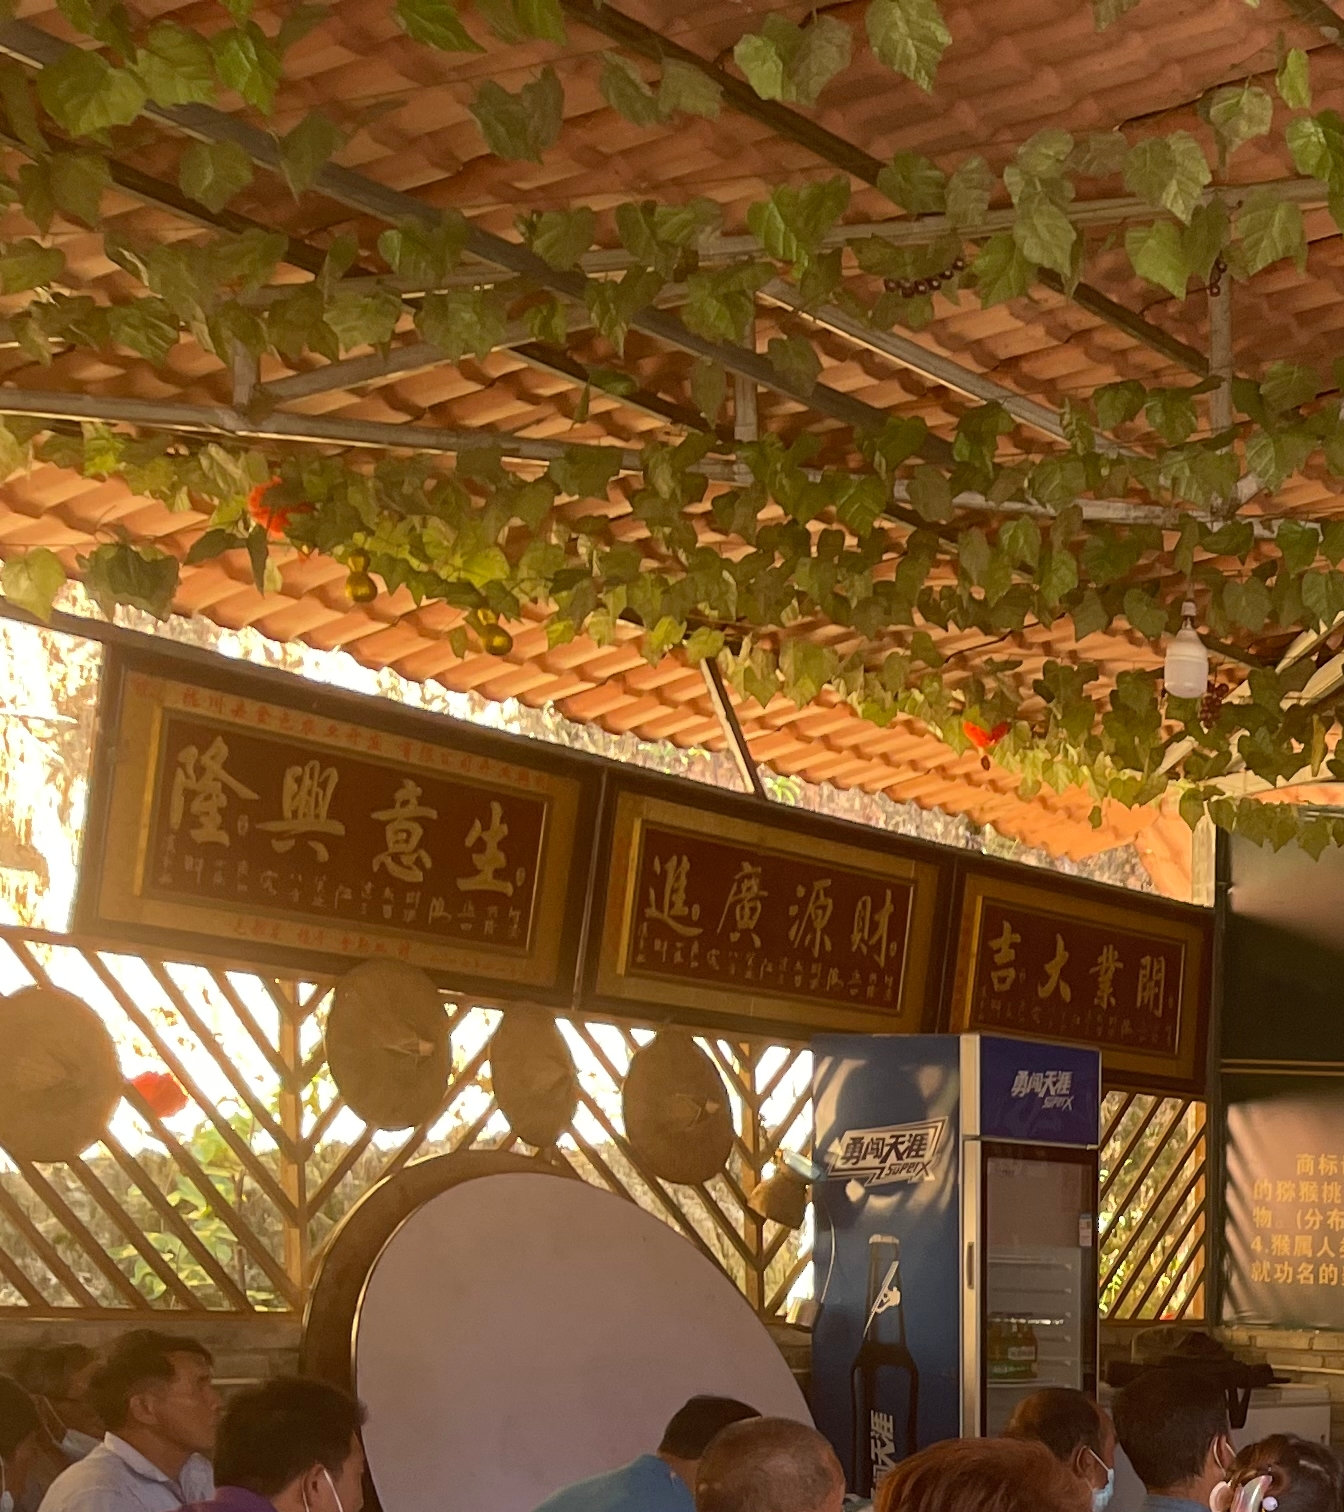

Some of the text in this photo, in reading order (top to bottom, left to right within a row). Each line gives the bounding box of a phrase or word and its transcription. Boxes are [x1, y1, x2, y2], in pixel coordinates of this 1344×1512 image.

[1010, 1069, 1074, 1099] 勇闯天涯
[840, 1131, 931, 1166] 勇闯天涯
